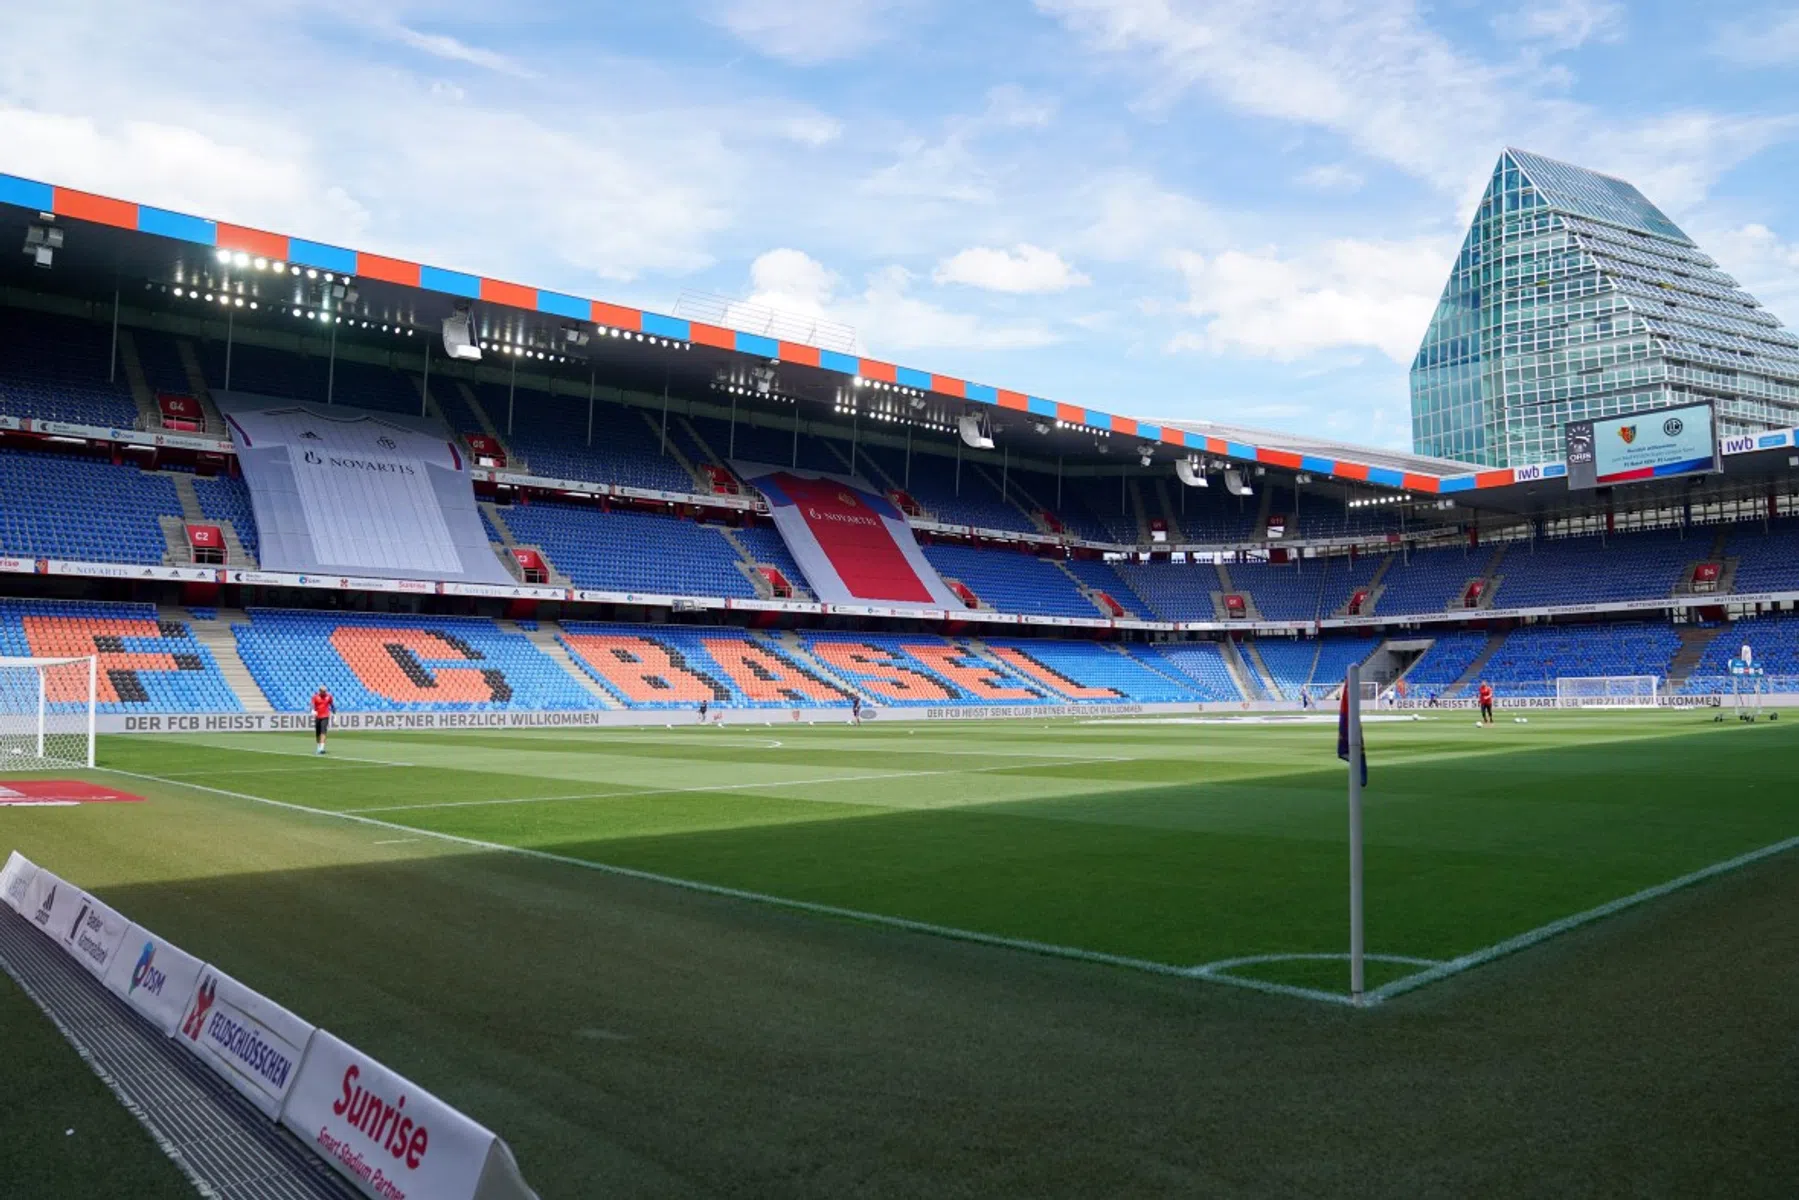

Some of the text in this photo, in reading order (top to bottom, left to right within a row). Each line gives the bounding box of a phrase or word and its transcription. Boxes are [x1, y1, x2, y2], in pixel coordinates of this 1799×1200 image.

[330, 456, 415, 475] NOVARTIS
[823, 512, 877, 526] NOVARTIS
[195, 531, 209, 542] C2
[928, 709, 944, 718] DER
[962, 708, 988, 718] HEISST
[990, 707, 1012, 717] SEINE
[1014, 706, 1032, 716] CLUB
[1033, 705, 1065, 715] PARTNER
[1100, 703, 1143, 714] WILLKOMMEN
[1397, 700, 1415, 709] DER
[1501, 698, 1527, 707] CLUB
[1582, 696, 1634, 706] HERZLICH
[125, 716, 161, 730] DER
[167, 716, 200, 730] FCB
[206, 716, 265, 729] HEISST
[365, 714, 434, 728] PARTNER
[440, 713, 507, 726] HERZLICH
[511, 712, 600, 725] WILLKOMMEN
[207, 1011, 293, 1090] FELDSCHLÖSSCHEN
[332, 1063, 429, 1171] Sunrise
[317, 1125, 342, 1157] Smart
[338, 1143, 373, 1181] Stadium
